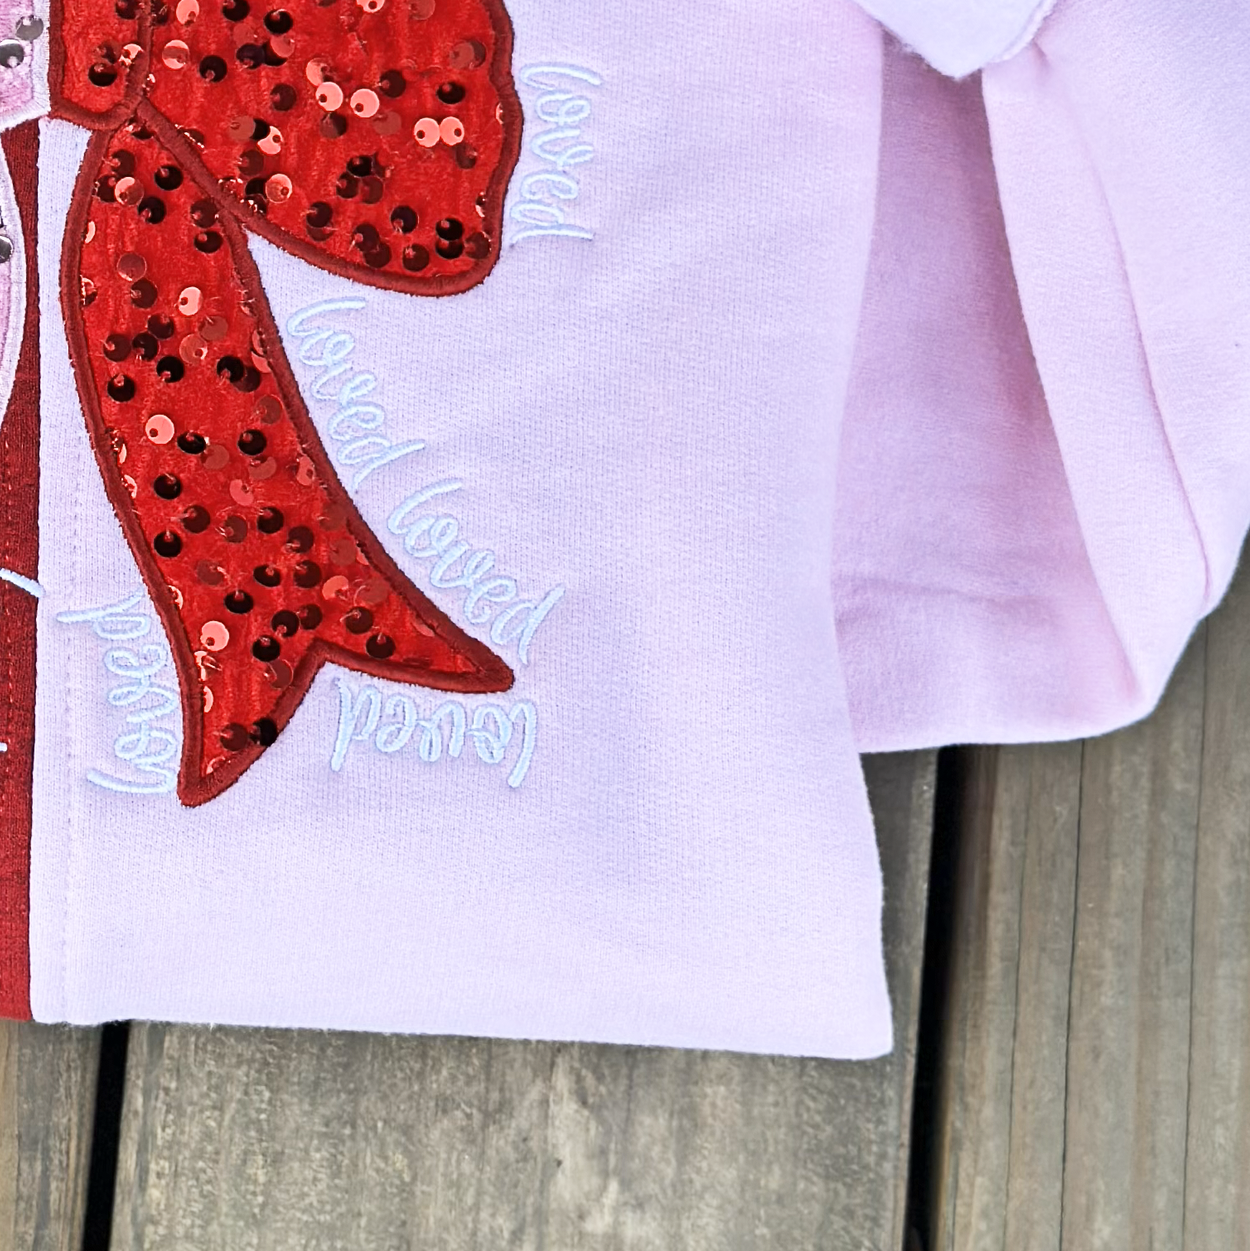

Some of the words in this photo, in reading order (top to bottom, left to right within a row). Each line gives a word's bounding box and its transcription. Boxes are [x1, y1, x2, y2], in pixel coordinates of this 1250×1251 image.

[507, 61, 603, 248] loved
[287, 296, 426, 492] loved
[387, 478, 566, 667] loved
[56, 591, 183, 795] loved
[330, 676, 538, 788] loved
